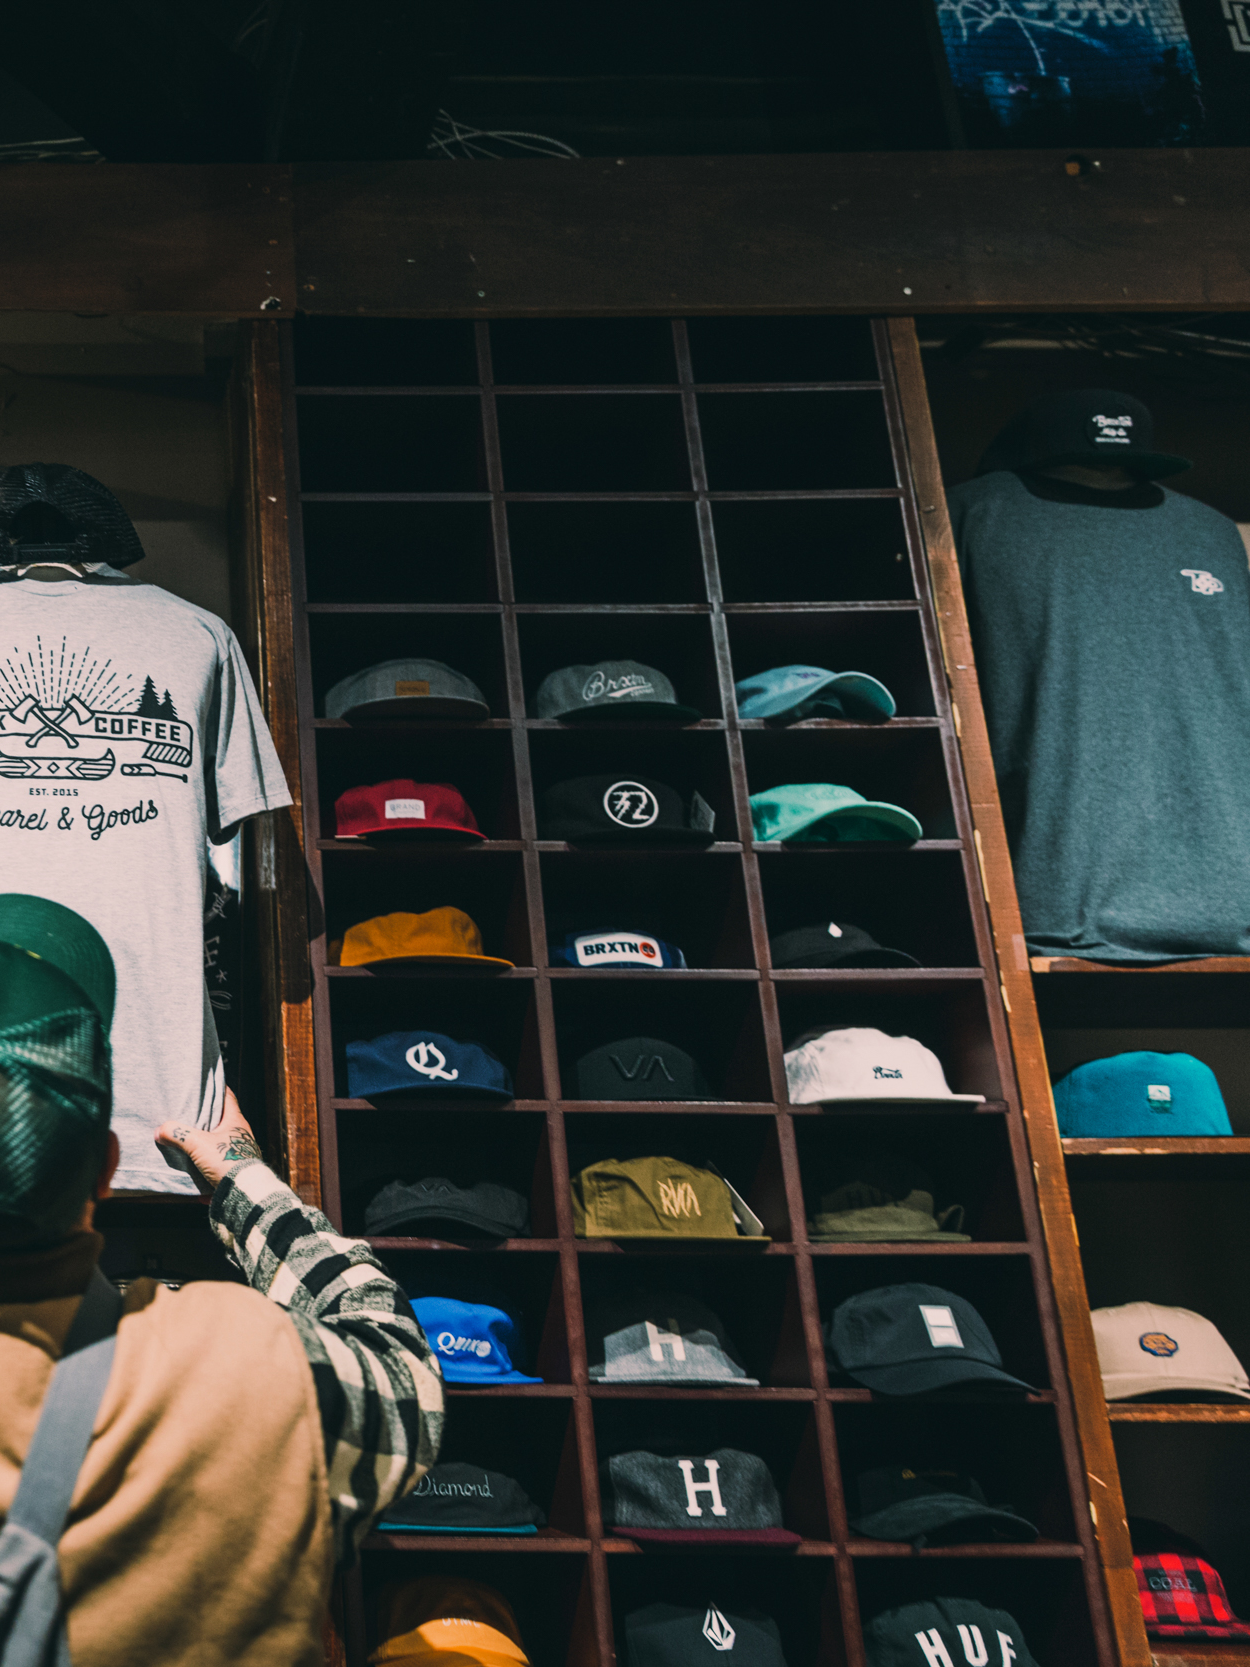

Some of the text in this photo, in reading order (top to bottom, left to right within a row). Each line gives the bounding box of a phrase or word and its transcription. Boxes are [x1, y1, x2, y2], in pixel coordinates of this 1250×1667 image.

[94, 716, 182, 743] COFFEE
[28, 787, 80, 797] EST. 2015
[57, 806, 74, 831] &
[81, 799, 159, 841] Goods
[583, 941, 640, 956] BRXTN
[412, 1474, 494, 1499] Diamond
[678, 1458, 727, 1517] H
[1148, 1576, 1198, 1593] COAL
[913, 1623, 1018, 1667] HUF
